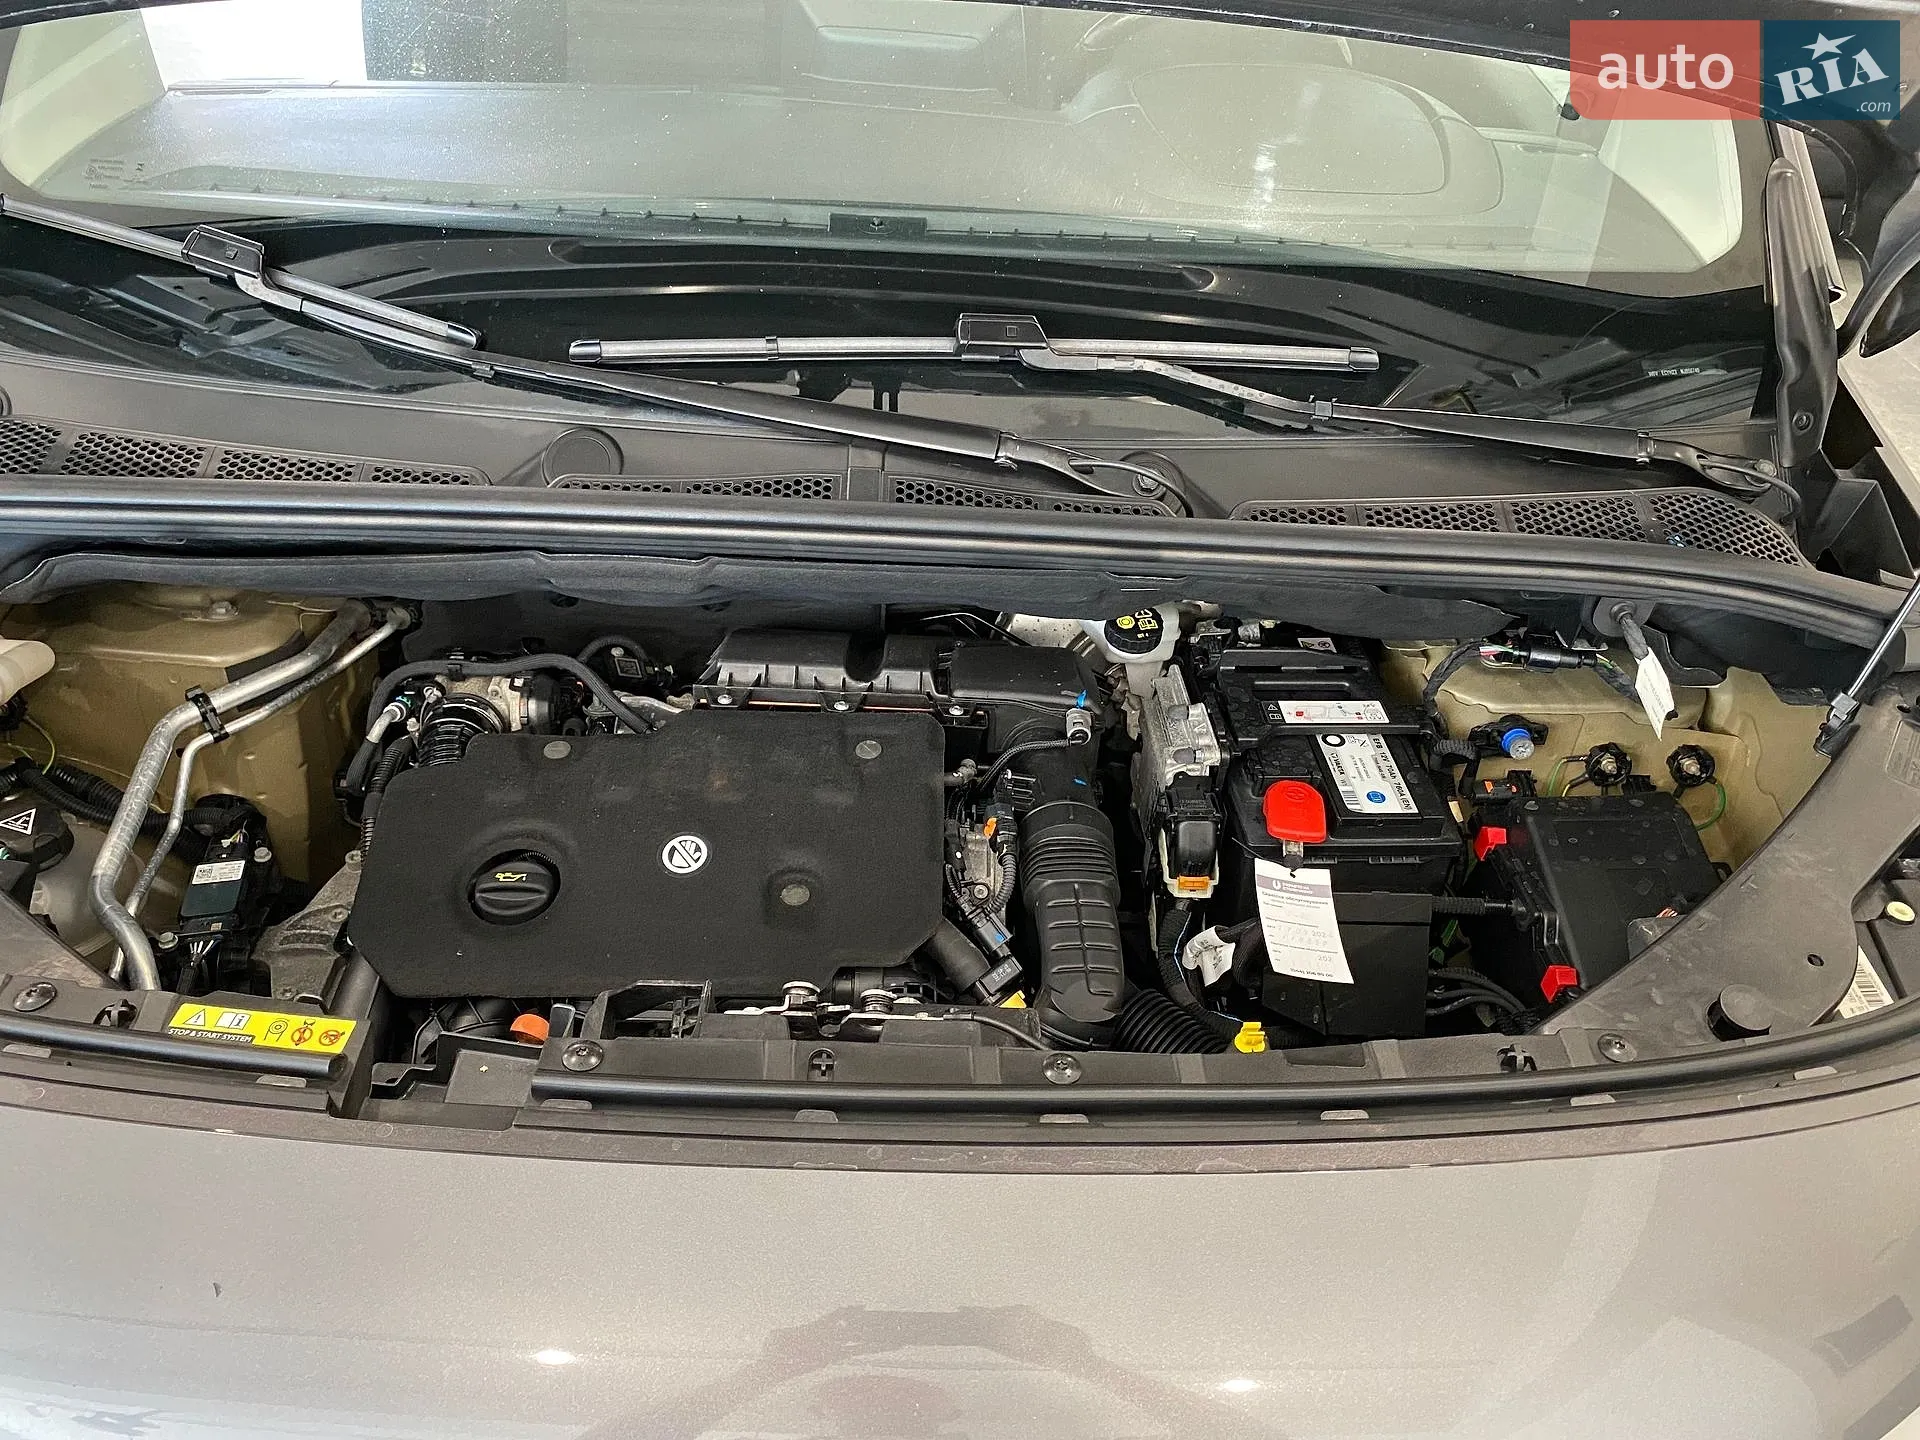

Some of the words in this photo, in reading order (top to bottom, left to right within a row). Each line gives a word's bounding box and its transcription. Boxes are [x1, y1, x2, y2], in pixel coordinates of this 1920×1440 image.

[1373, 738, 1383, 749] EFB
[168, 1028, 189, 1036] STOP
[196, 1031, 221, 1039] START
[221, 1033, 252, 1042] SYSTEM
